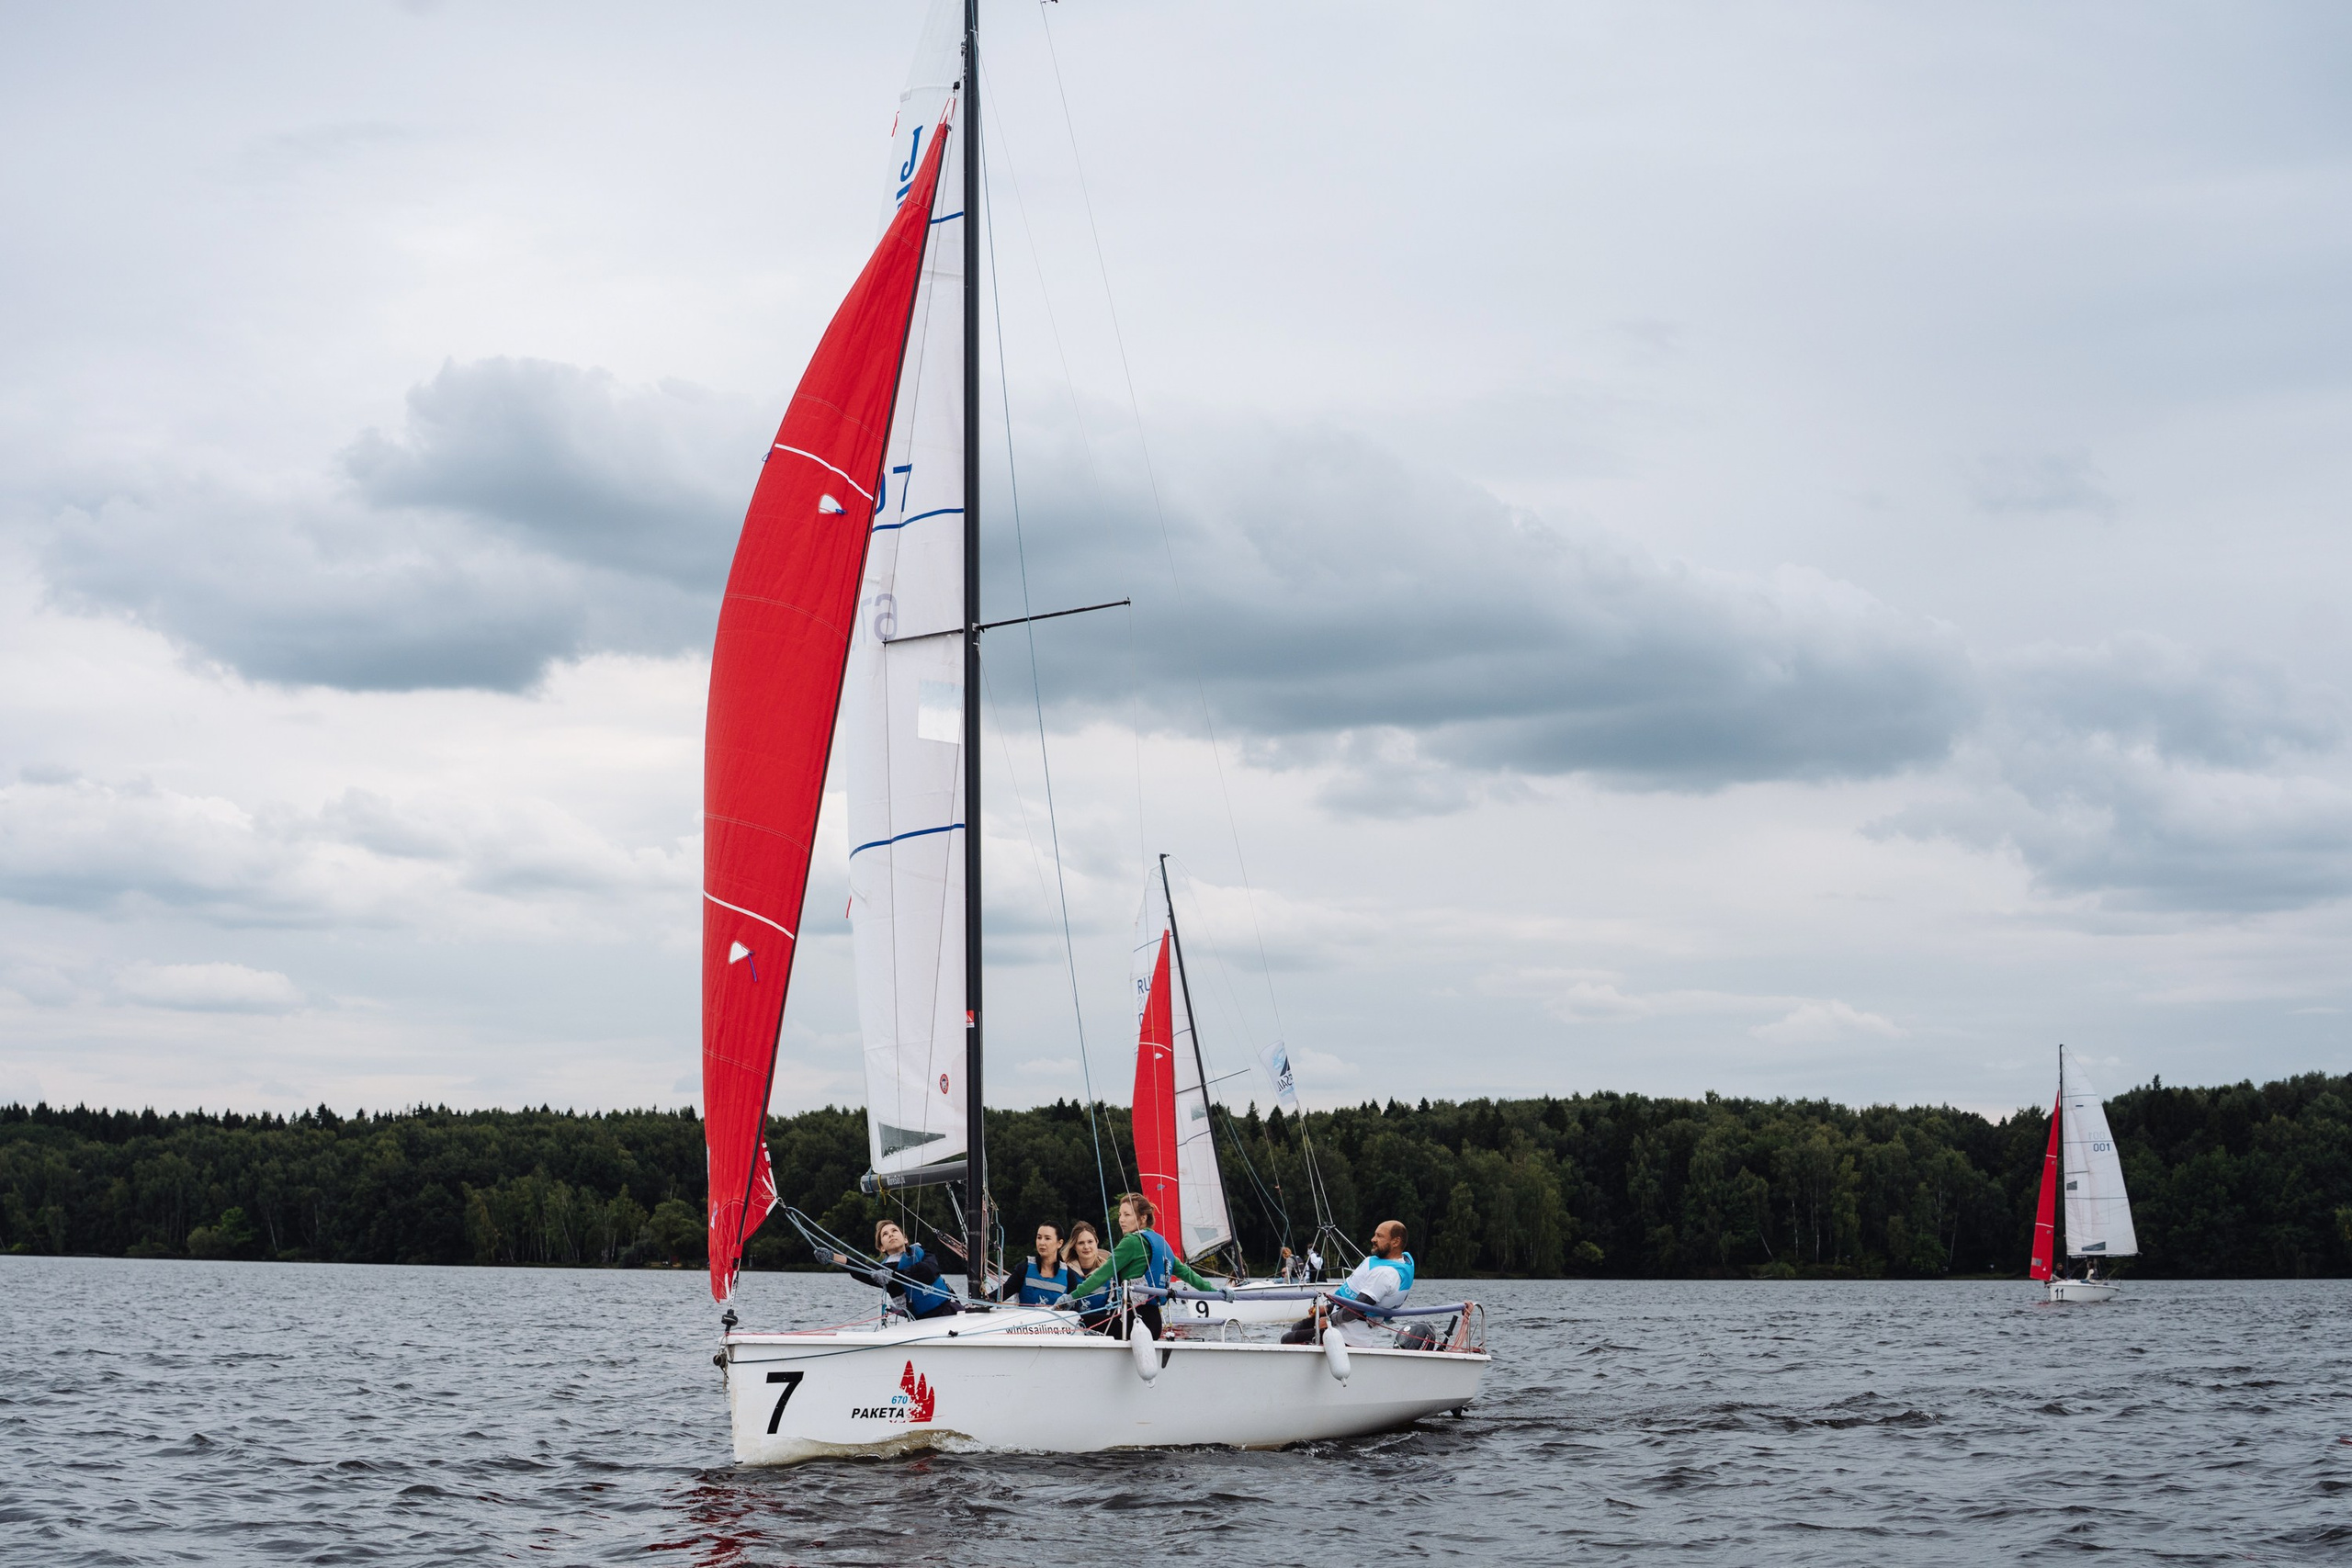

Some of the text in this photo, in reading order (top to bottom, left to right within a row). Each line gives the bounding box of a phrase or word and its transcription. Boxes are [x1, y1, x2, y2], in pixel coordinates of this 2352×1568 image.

[1137, 976, 1154, 995] RU
[2093, 1143, 2110, 1152] 001
[2054, 1288, 2064, 1299] 11
[1195, 1300, 1210, 1318] 9
[766, 1371, 804, 1434] 7
[891, 1395, 909, 1404] 670
